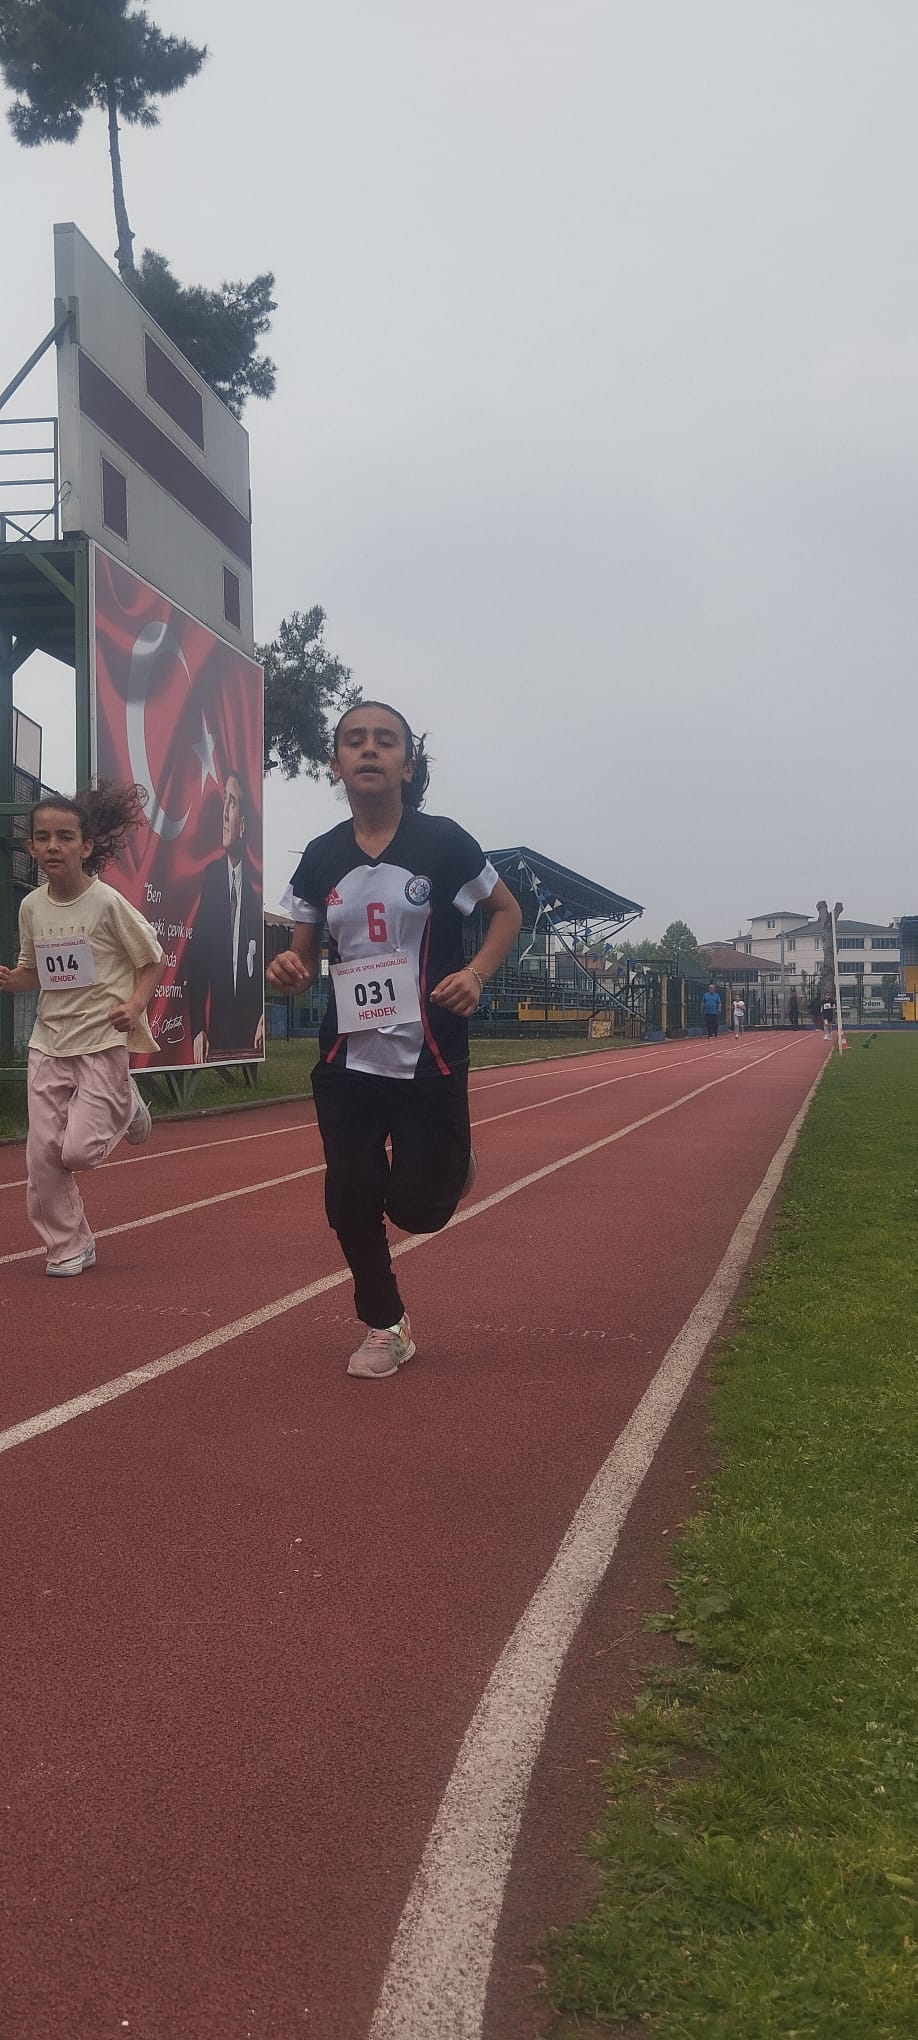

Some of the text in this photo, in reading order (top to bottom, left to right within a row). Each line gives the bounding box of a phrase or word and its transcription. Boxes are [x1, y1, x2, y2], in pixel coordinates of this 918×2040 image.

[367, 902, 388, 943] 6
[46, 954, 79, 973] 014
[50, 974, 78, 983] HENDEK
[354, 979, 396, 1006] 031
[358, 1006, 397, 1021] HENDEK
